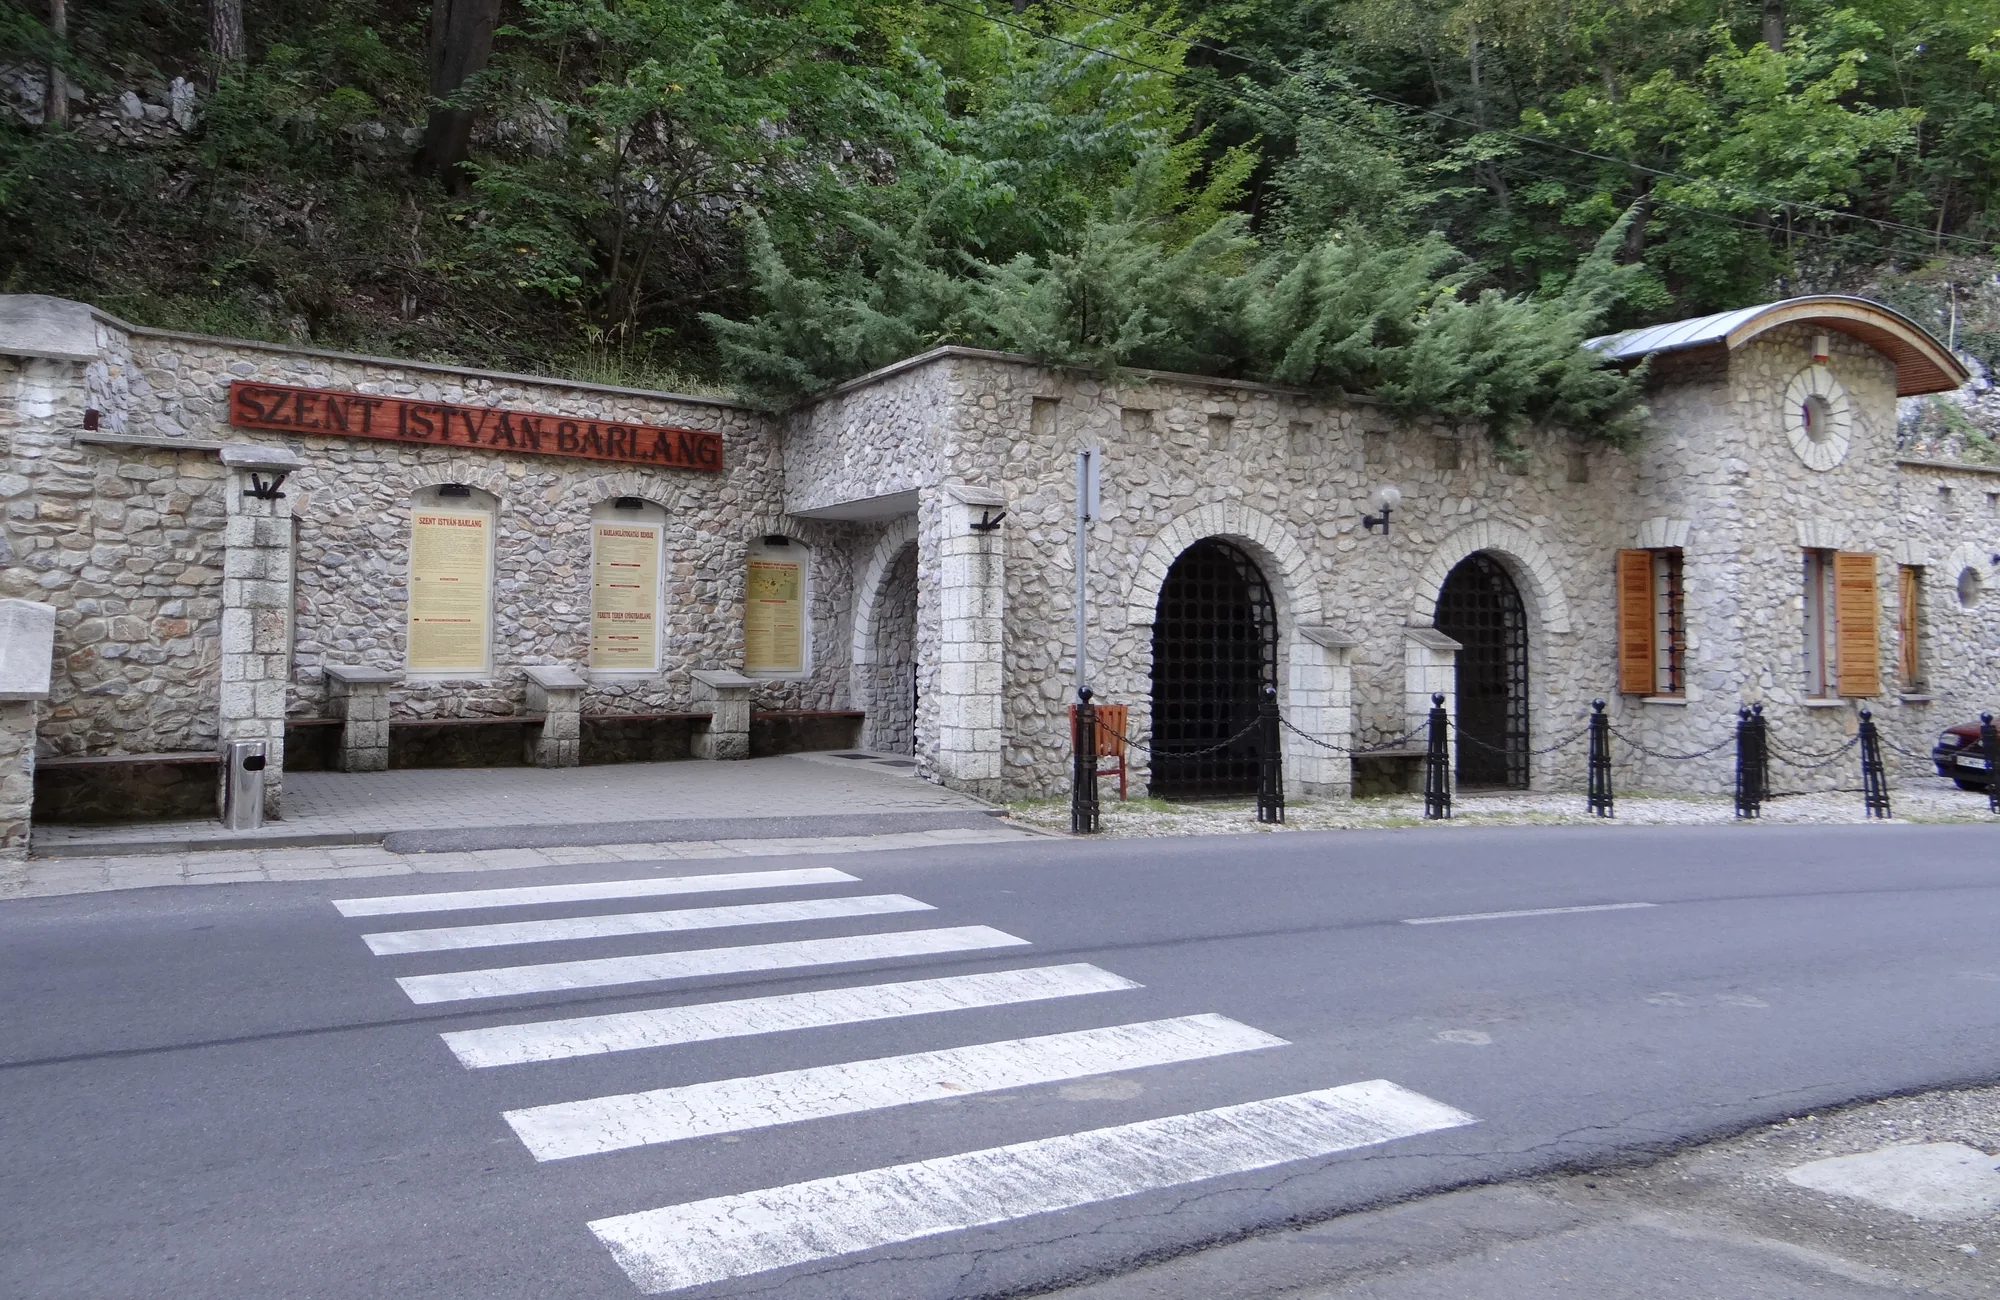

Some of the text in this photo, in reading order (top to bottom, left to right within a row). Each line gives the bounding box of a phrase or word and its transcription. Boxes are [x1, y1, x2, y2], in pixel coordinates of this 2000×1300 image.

[237, 386, 718, 466] SZENT ISTVÁN-BARLANG
[419, 517, 482, 527] SZENT ISTVÁN-BARLANG
